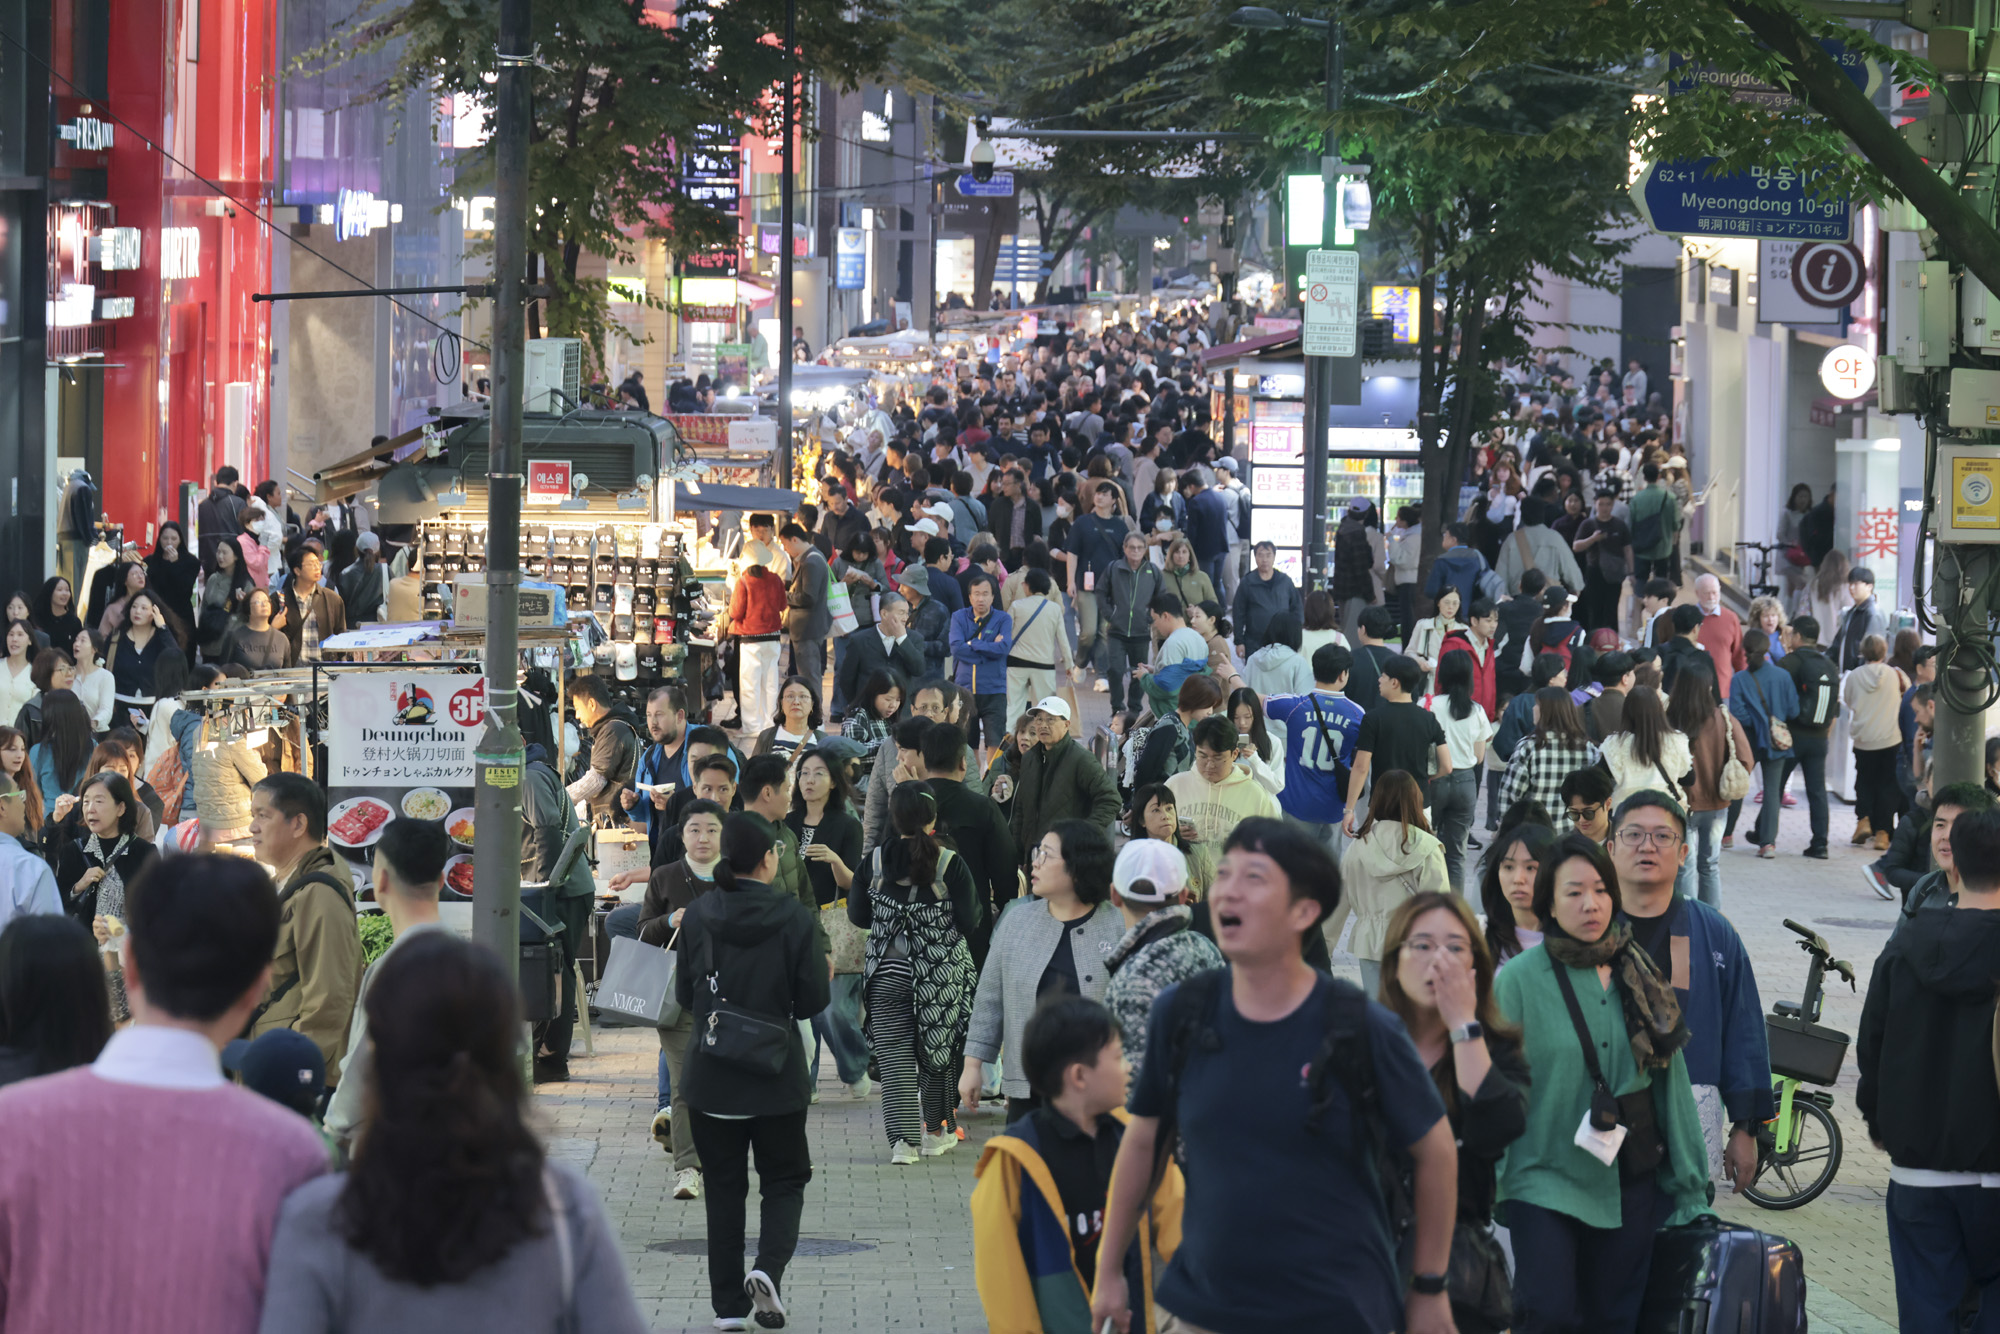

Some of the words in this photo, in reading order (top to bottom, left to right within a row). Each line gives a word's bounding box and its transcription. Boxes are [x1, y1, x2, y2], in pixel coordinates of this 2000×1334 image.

[1842, 53, 1856, 66] 52
[1659, 169, 1674, 182] 62
[1689, 171, 1695, 183] 1
[1751, 165, 1824, 190] 명동10
[1682, 192, 1792, 216] Myeongdong
[1798, 198, 1844, 218] 10-gil
[1698, 218, 1750, 233] 明洞10街
[1756, 222, 1842, 237] ミョンドン10ギル
[1770, 256, 1793, 265] FR
[1834, 358, 1862, 389] 약
[537, 473, 564, 485] 에스원
[452, 695, 484, 722] 3F
[1305, 710, 1351, 729] ZIDANE
[362, 727, 465, 745] Deungchon
[362, 747, 465, 762] 登村火锅刀切面
[1299, 725, 1344, 771] 10
[343, 766, 476, 778] ドゥンチョンしゃぶカルグク
[610, 991, 646, 1015] NMGR
